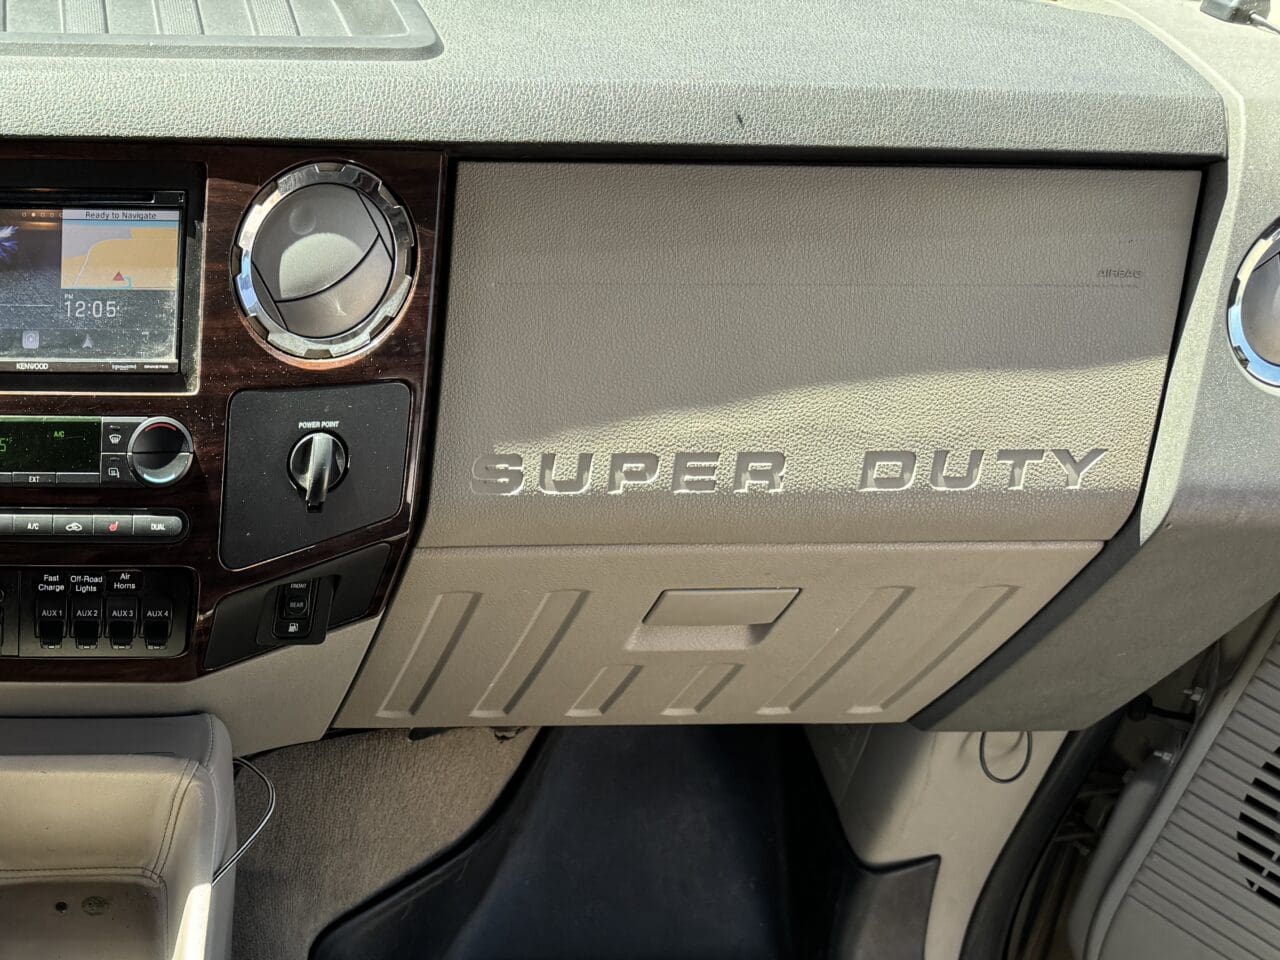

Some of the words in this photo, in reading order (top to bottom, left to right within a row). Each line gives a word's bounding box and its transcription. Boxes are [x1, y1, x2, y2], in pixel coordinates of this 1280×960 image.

[85, 211, 109, 220] Ready
[122, 211, 157, 220] Navigate
[64, 300, 116, 318] 12:05
[298, 421, 320, 429] POWER
[321, 420, 339, 428] POINT
[470, 452, 786, 496] SUPER
[858, 449, 1109, 491] DUTY
[27, 522, 39, 530] A/C
[43, 574, 60, 582] Fast
[70, 575, 103, 583] Off-Road
[38, 584, 65, 592] Charge
[75, 585, 97, 593] Lights
